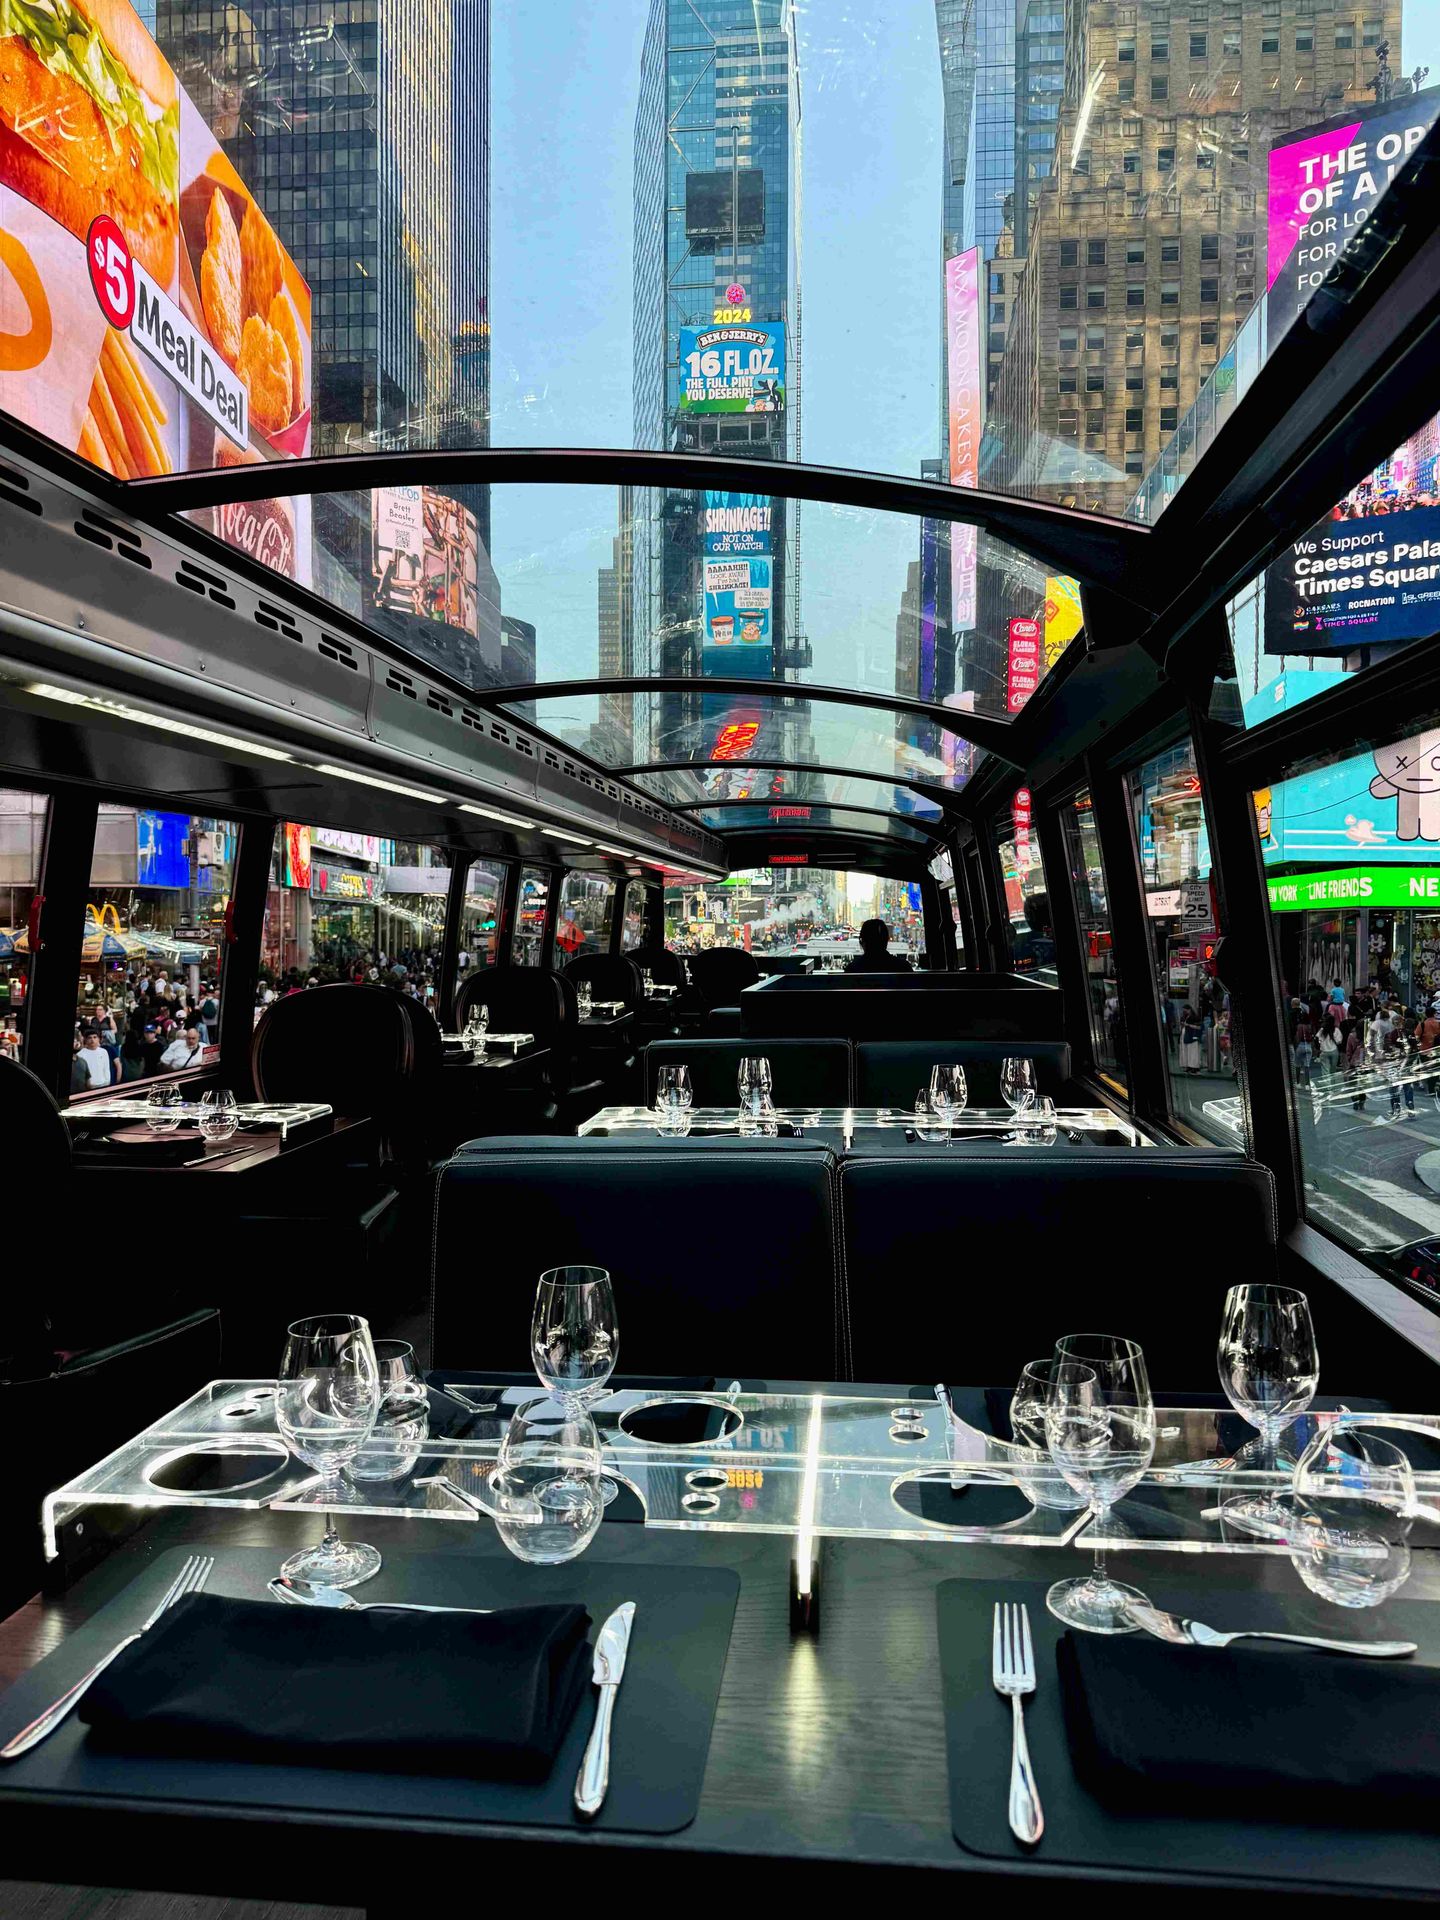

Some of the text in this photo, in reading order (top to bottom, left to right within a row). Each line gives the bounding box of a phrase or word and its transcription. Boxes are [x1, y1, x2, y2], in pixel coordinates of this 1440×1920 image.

[1299, 142, 1367, 184] THE
[1376, 122, 1433, 161] OP
[1299, 180, 1345, 214] OF
[1352, 171, 1378, 201] A
[1298, 217, 1337, 241] FOR
[1298, 242, 1337, 266] FOR
[94, 236, 128, 316] $5
[953, 258, 969, 298] MX
[713, 308, 752, 325] 2024
[137, 280, 245, 436] Meal Deal
[685, 351, 721, 378] 16
[685, 376, 754, 389] THE FULL PINT
[685, 387, 754, 401] YOU DESERVE!
[954, 309, 972, 466] MOONCAKES
[393, 502, 411, 513] Brett
[706, 506, 771, 533] SHRINKAGE?!
[712, 542, 764, 551] OUR WATCH!
[722, 534, 754, 543] NOT ON
[1294, 530, 1385, 556] We Support
[1295, 540, 1440, 576] Caesars Pala
[1295, 564, 1440, 598] Times Squar
[1324, 620, 1345, 628] TIMES
[1278, 884, 1297, 902] YORK
[1328, 877, 1373, 899] FRIENDS
[1184, 904, 1208, 918] 25
